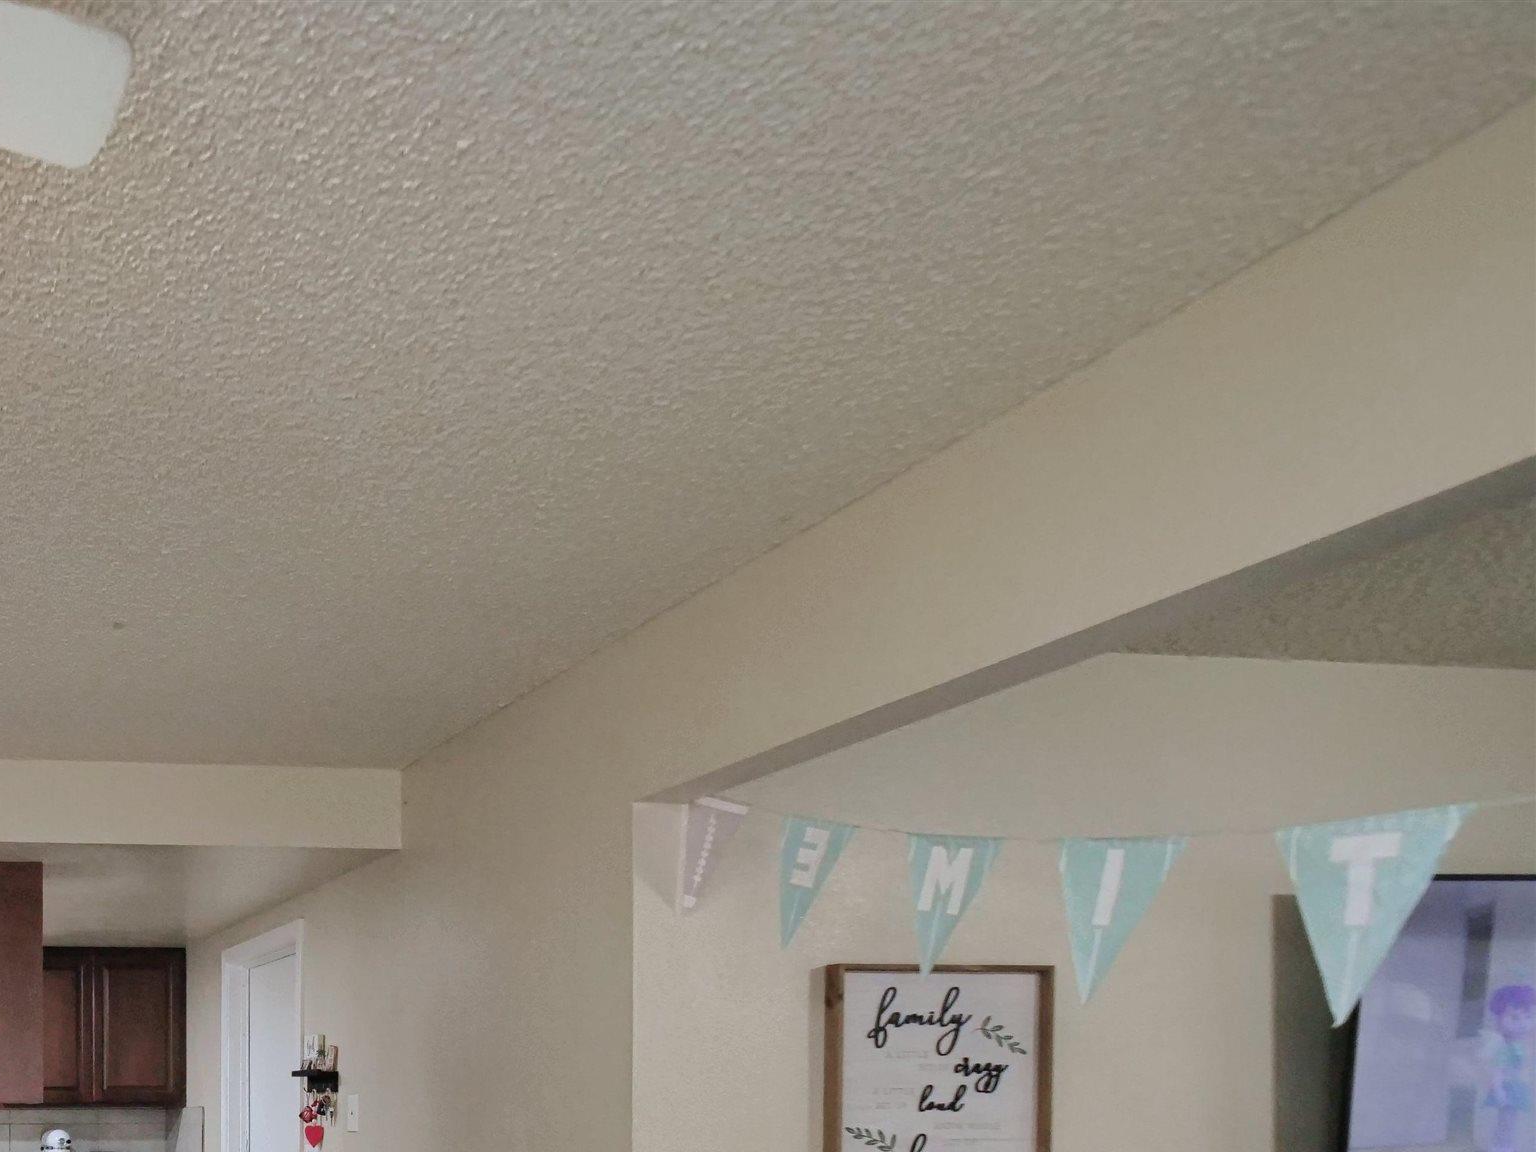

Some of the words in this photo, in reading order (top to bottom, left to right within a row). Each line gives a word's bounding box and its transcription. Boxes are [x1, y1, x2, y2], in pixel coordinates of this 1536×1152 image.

[867, 986, 972, 1056] family
[954, 1057, 1009, 1093] crazy
[918, 1084, 967, 1112] loud
